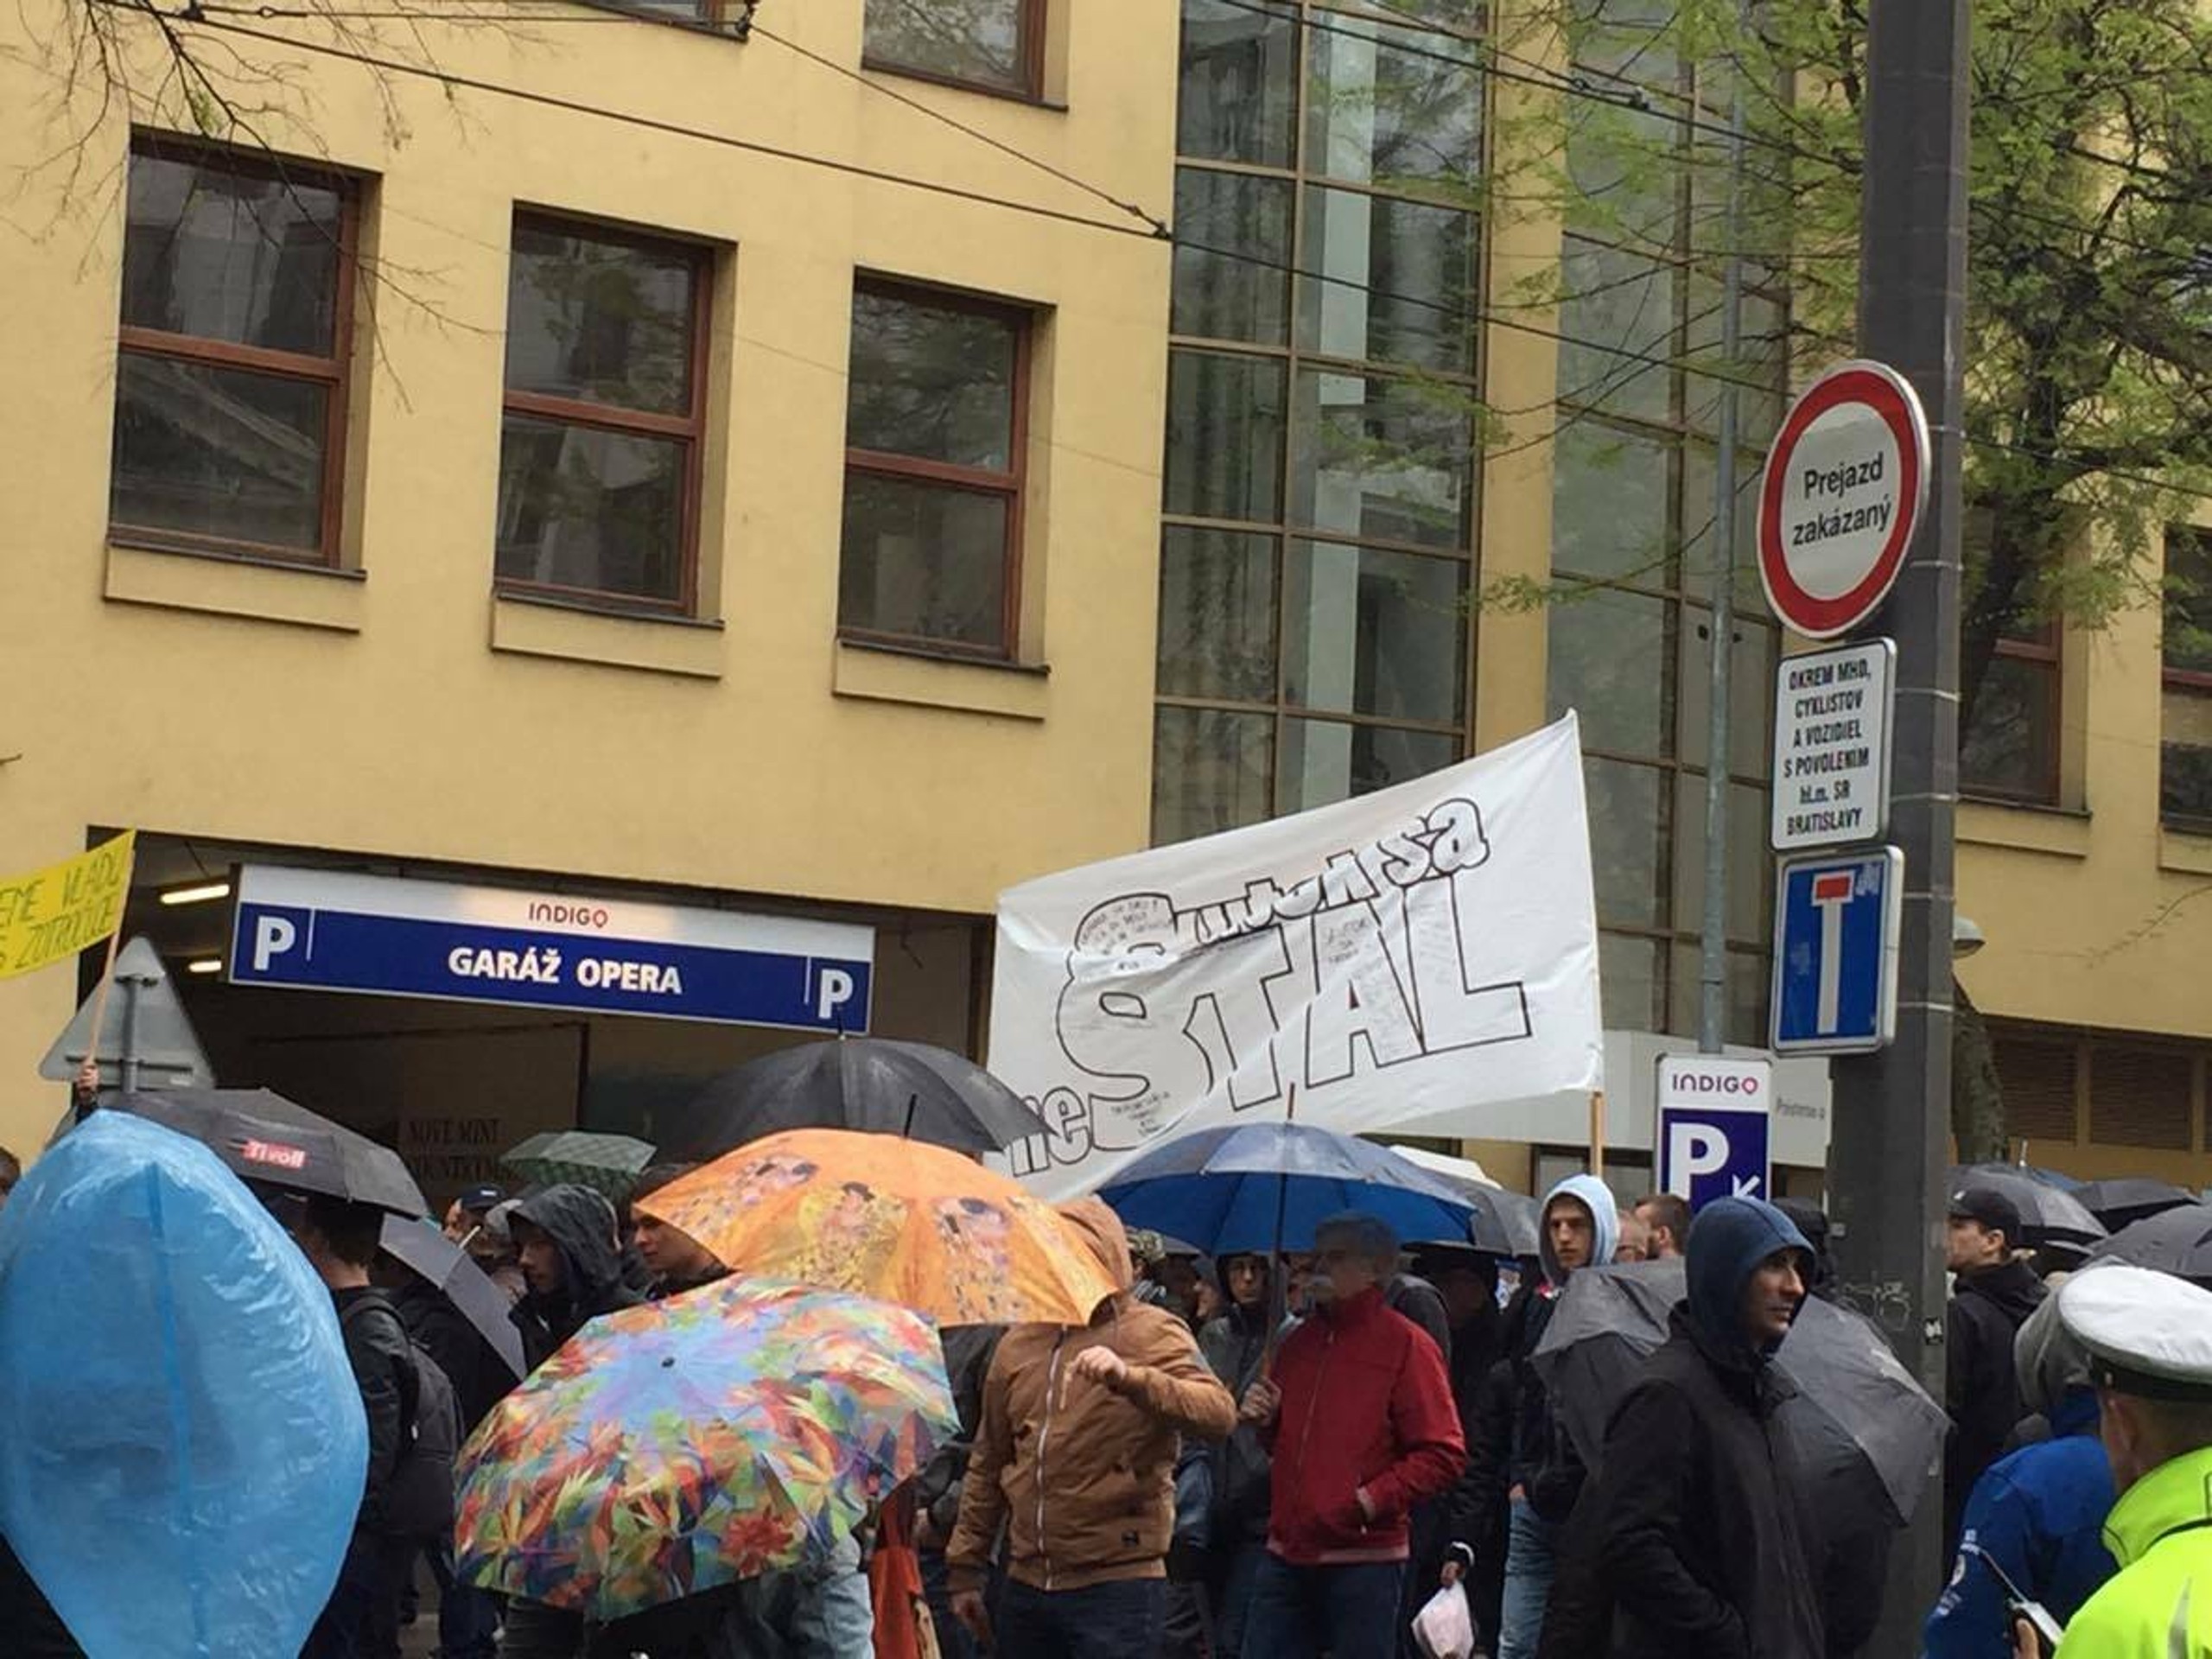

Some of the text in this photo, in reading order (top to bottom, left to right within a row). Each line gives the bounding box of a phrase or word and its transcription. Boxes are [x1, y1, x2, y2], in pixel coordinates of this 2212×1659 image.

[1804, 451, 1885, 499] Prejazd
[1793, 493, 1891, 545] zakázaný
[1789, 664, 1834, 690] OKREM
[1795, 690, 1864, 719] CYKLISTOV
[1793, 719, 1862, 748] A VOZIDIEL
[1784, 759, 1793, 778] S
[1834, 779, 1850, 800] SR
[1787, 808, 1863, 836] BRATISLAVY
[528, 902, 609, 929] INDIGO
[253, 914, 854, 1020] P GARÁŽ OPERA P
[1672, 1073, 1759, 1096] INDIGO
[1669, 1122, 1730, 1202] P
